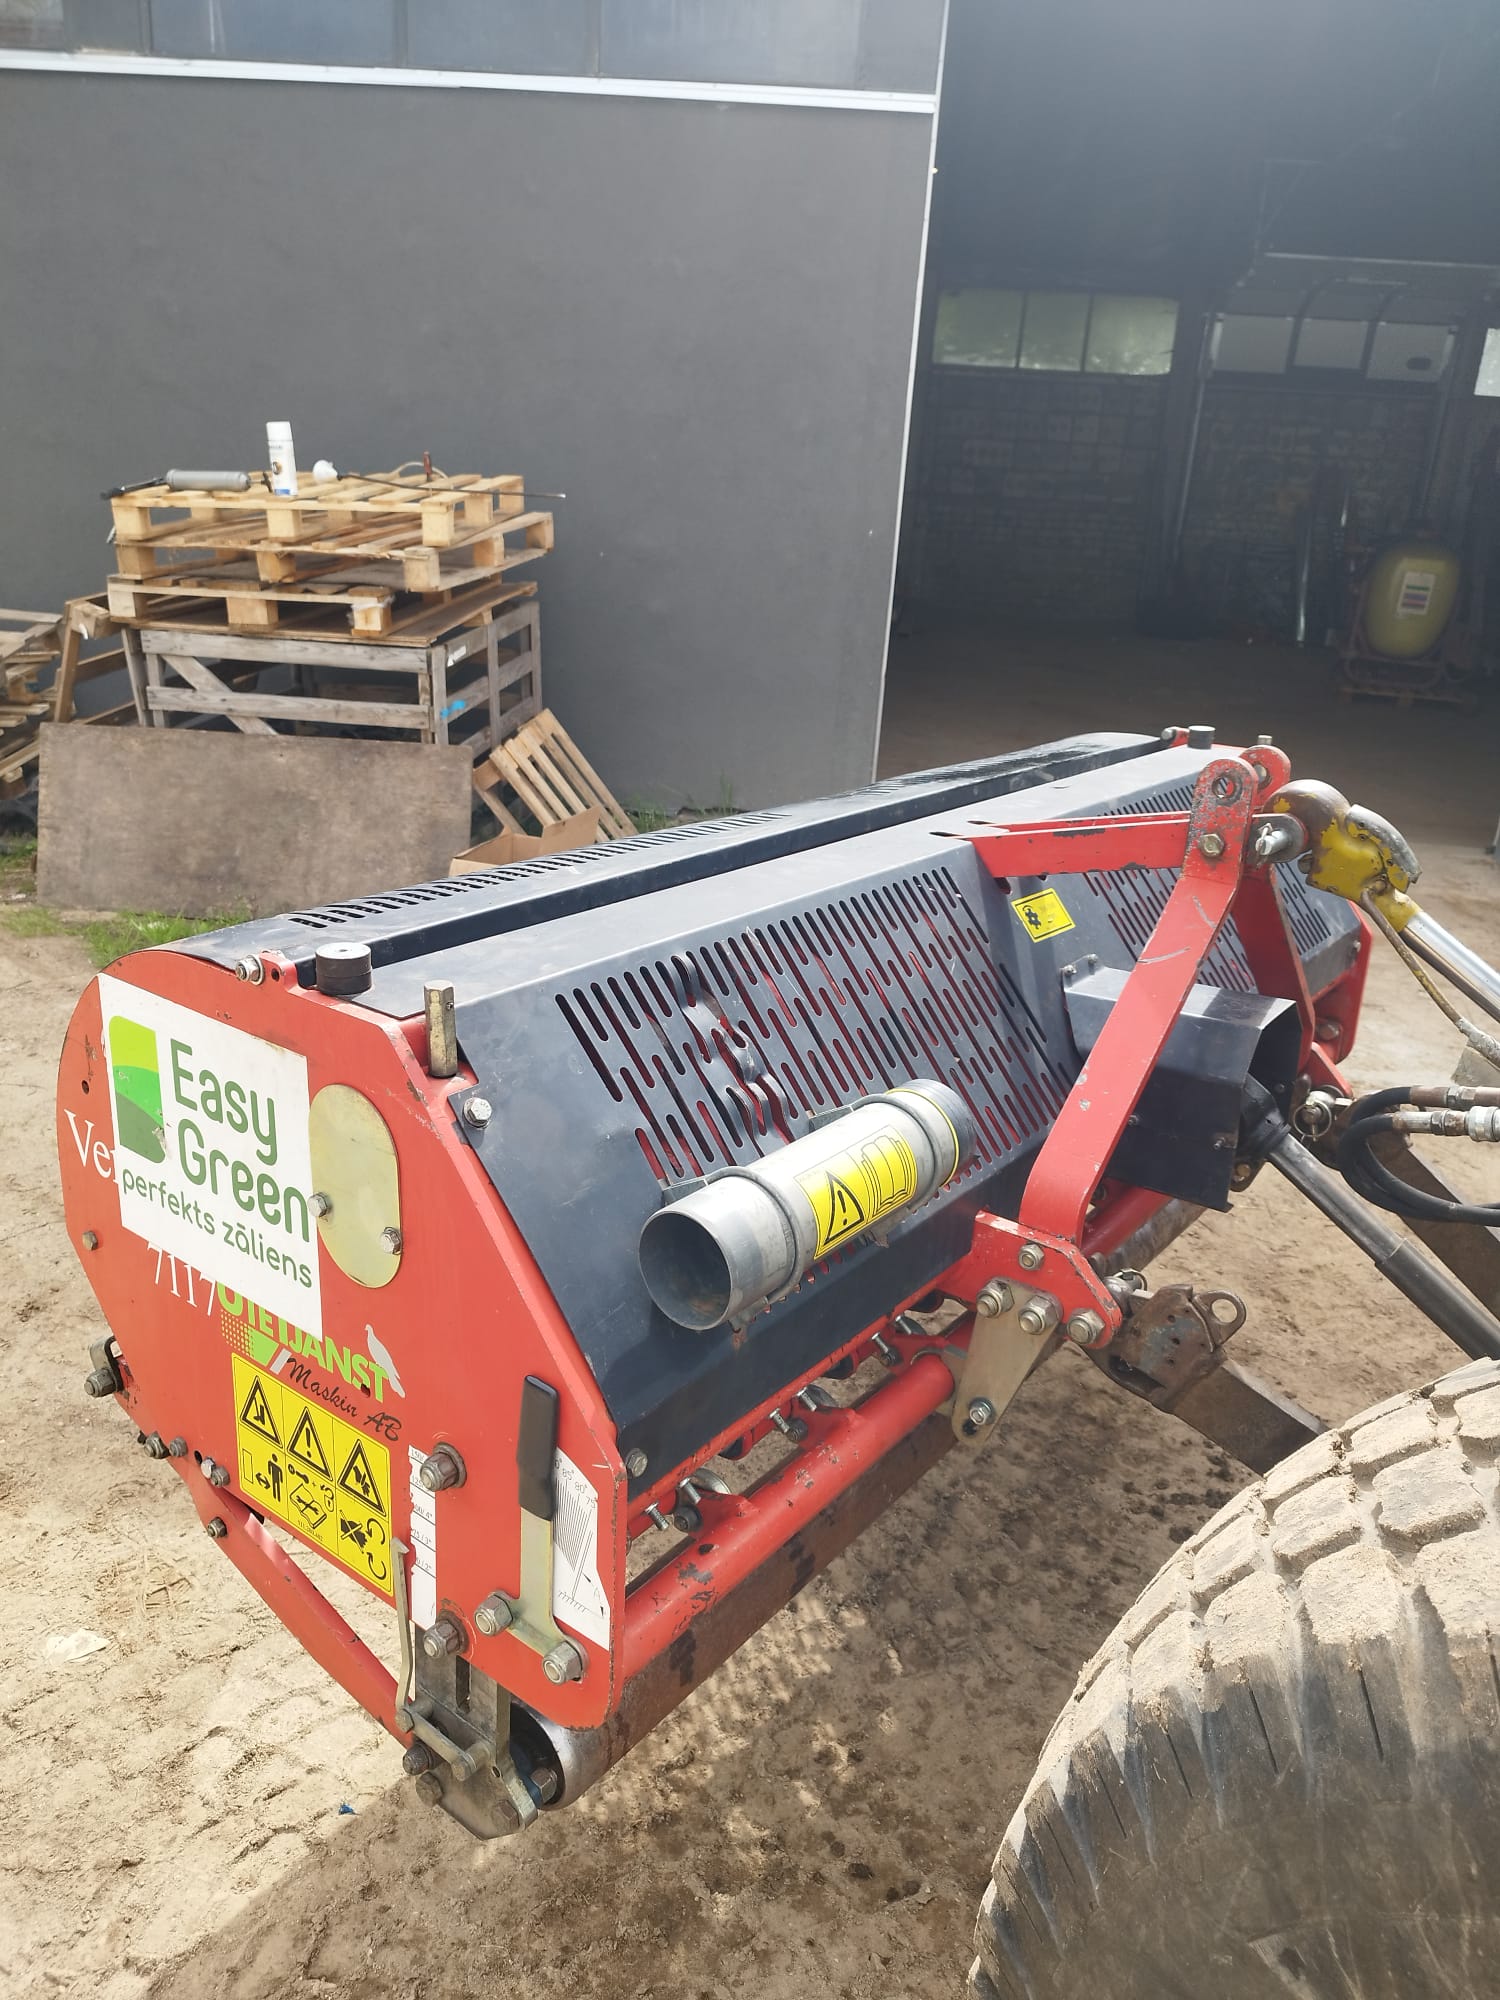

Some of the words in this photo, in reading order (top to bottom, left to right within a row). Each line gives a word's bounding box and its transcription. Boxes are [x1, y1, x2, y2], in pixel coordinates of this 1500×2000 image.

[170, 1038, 278, 1166] Easy
[122, 1168, 216, 1235] perfekts
[222, 1221, 312, 1288] zāliens
[178, 1118, 310, 1243] Green
[286, 1357, 358, 1417] Maskin
[363, 1411, 402, 1442] AB
